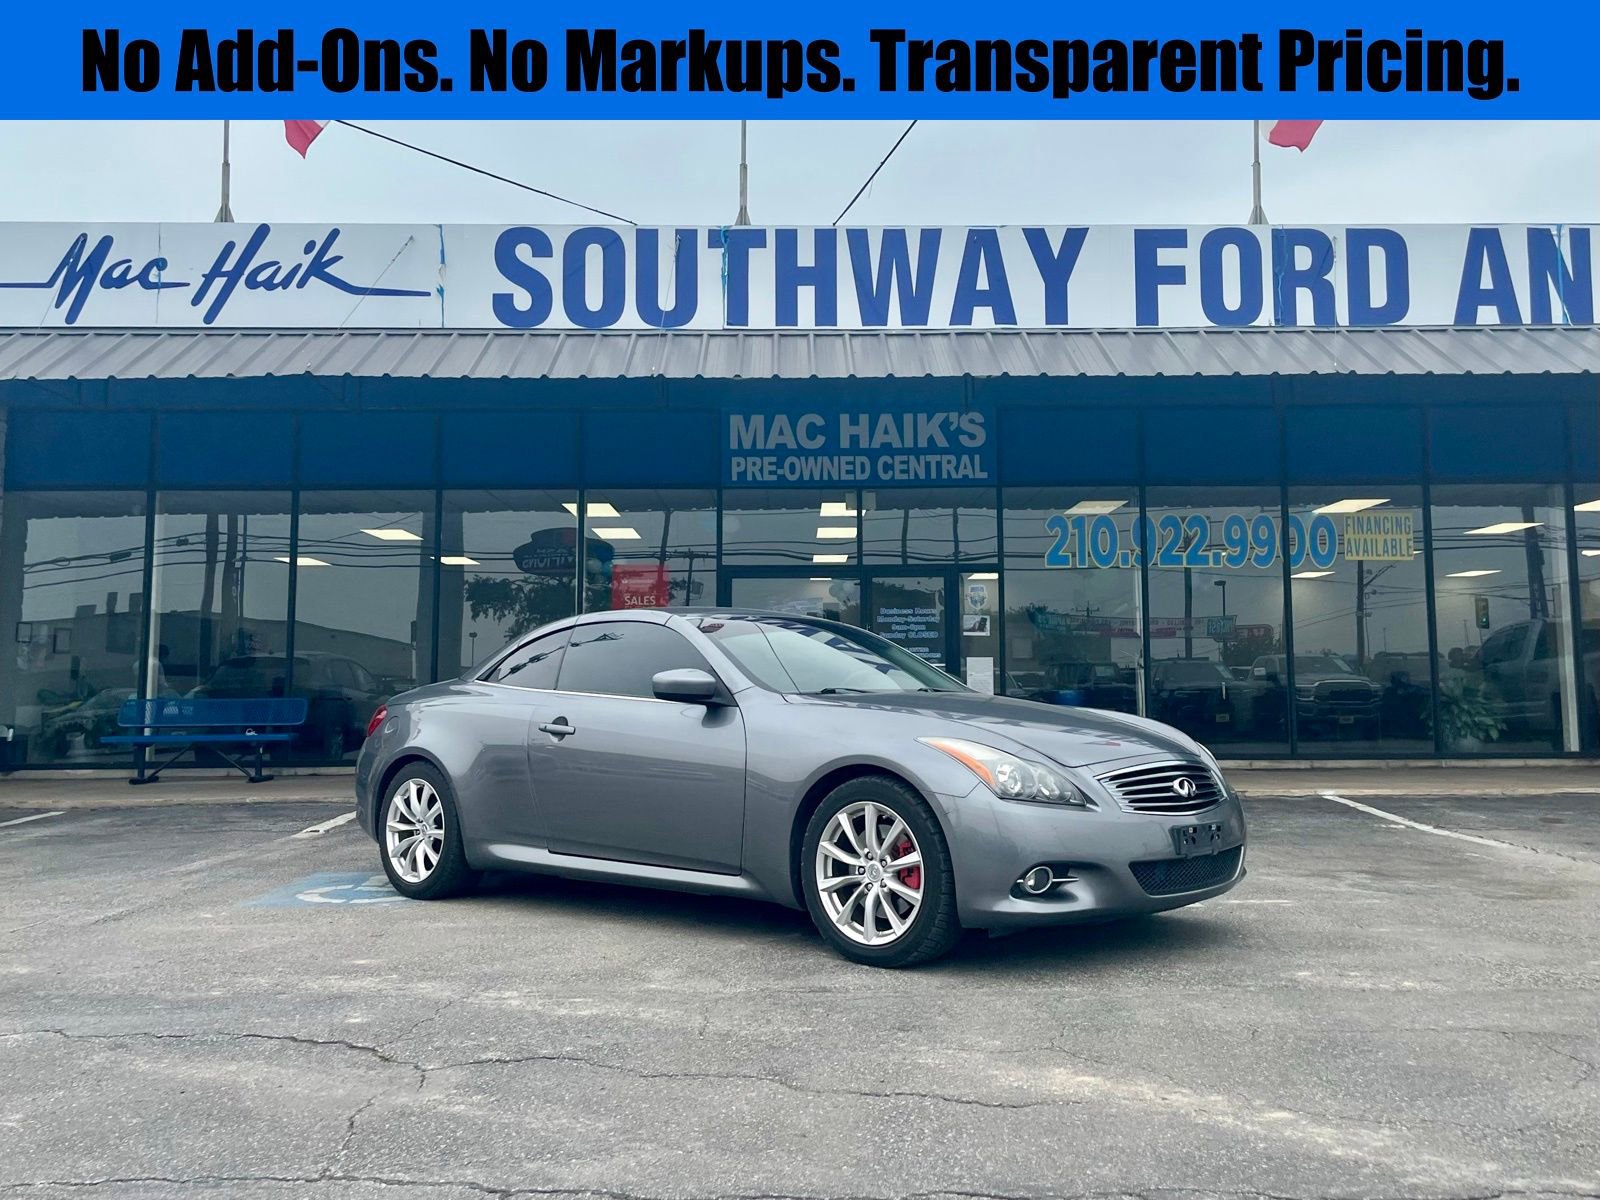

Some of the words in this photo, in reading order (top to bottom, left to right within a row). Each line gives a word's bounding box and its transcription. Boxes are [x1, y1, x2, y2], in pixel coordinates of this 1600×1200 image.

[30, 232, 190, 324] Mac
[191, 223, 431, 324] Haik
[493, 227, 1088, 330] SOUTHWAY
[1135, 228, 1409, 327] FORD
[1455, 227, 1593, 325] AN
[729, 414, 826, 449] MAC
[731, 455, 871, 481] PRE-OWNED
[877, 453, 988, 479] CENTRAL
[1345, 515, 1412, 535] FINANCING
[1045, 513, 1338, 569] 210.922.9900
[1345, 537, 1413, 557] AVAILABLE
[624, 595, 656, 606] SALES
